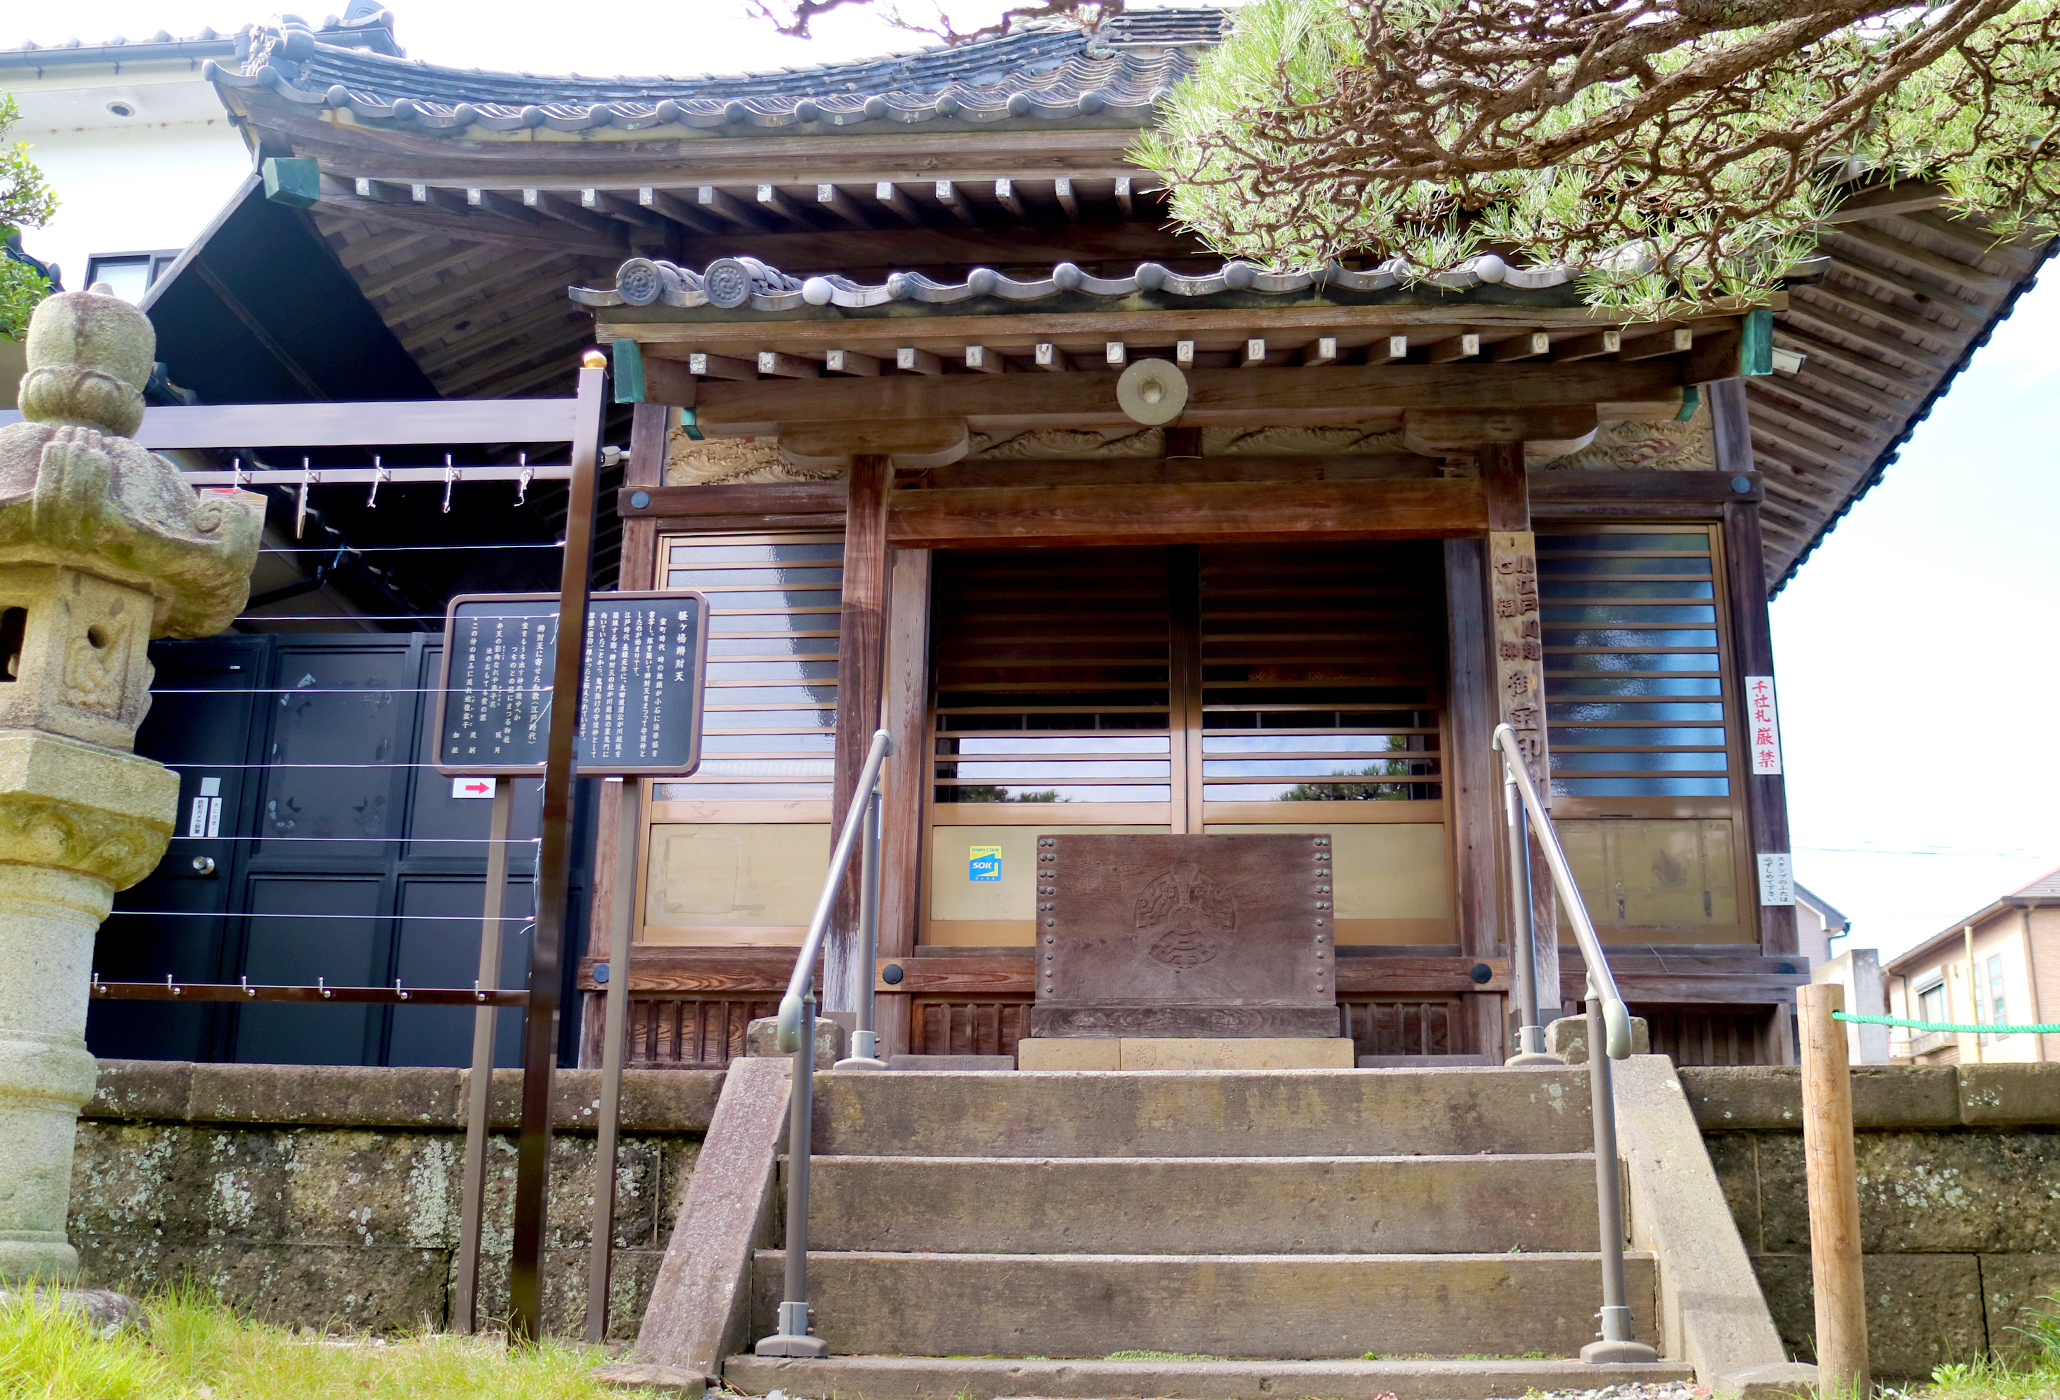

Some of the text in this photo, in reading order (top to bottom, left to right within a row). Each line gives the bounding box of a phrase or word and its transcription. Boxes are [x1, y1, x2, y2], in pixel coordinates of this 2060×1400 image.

[1494, 556, 1520, 661] 七福神
[1752, 680, 1775, 768] 千社札厳禁
[972, 861, 992, 869] SOK
